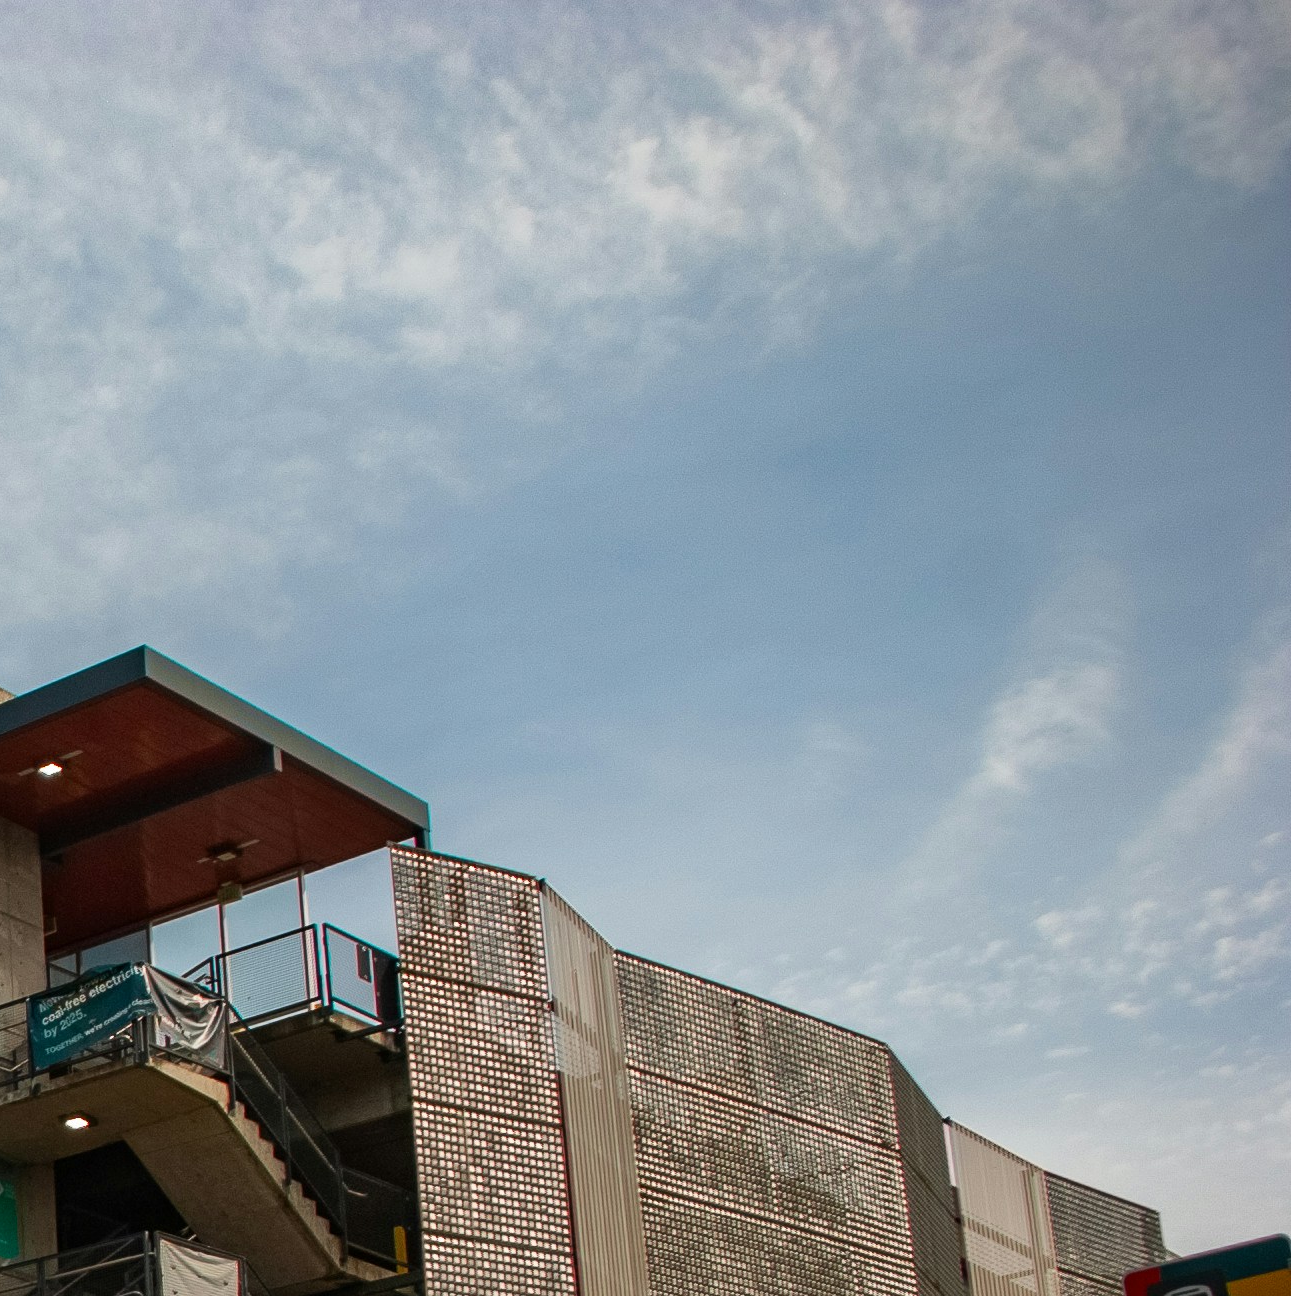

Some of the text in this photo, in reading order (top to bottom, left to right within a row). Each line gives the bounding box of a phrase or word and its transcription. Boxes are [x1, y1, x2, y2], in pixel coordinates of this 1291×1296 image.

[42, 965, 145, 1026] coal-free electricity
[44, 1009, 88, 1039] by 2025.
